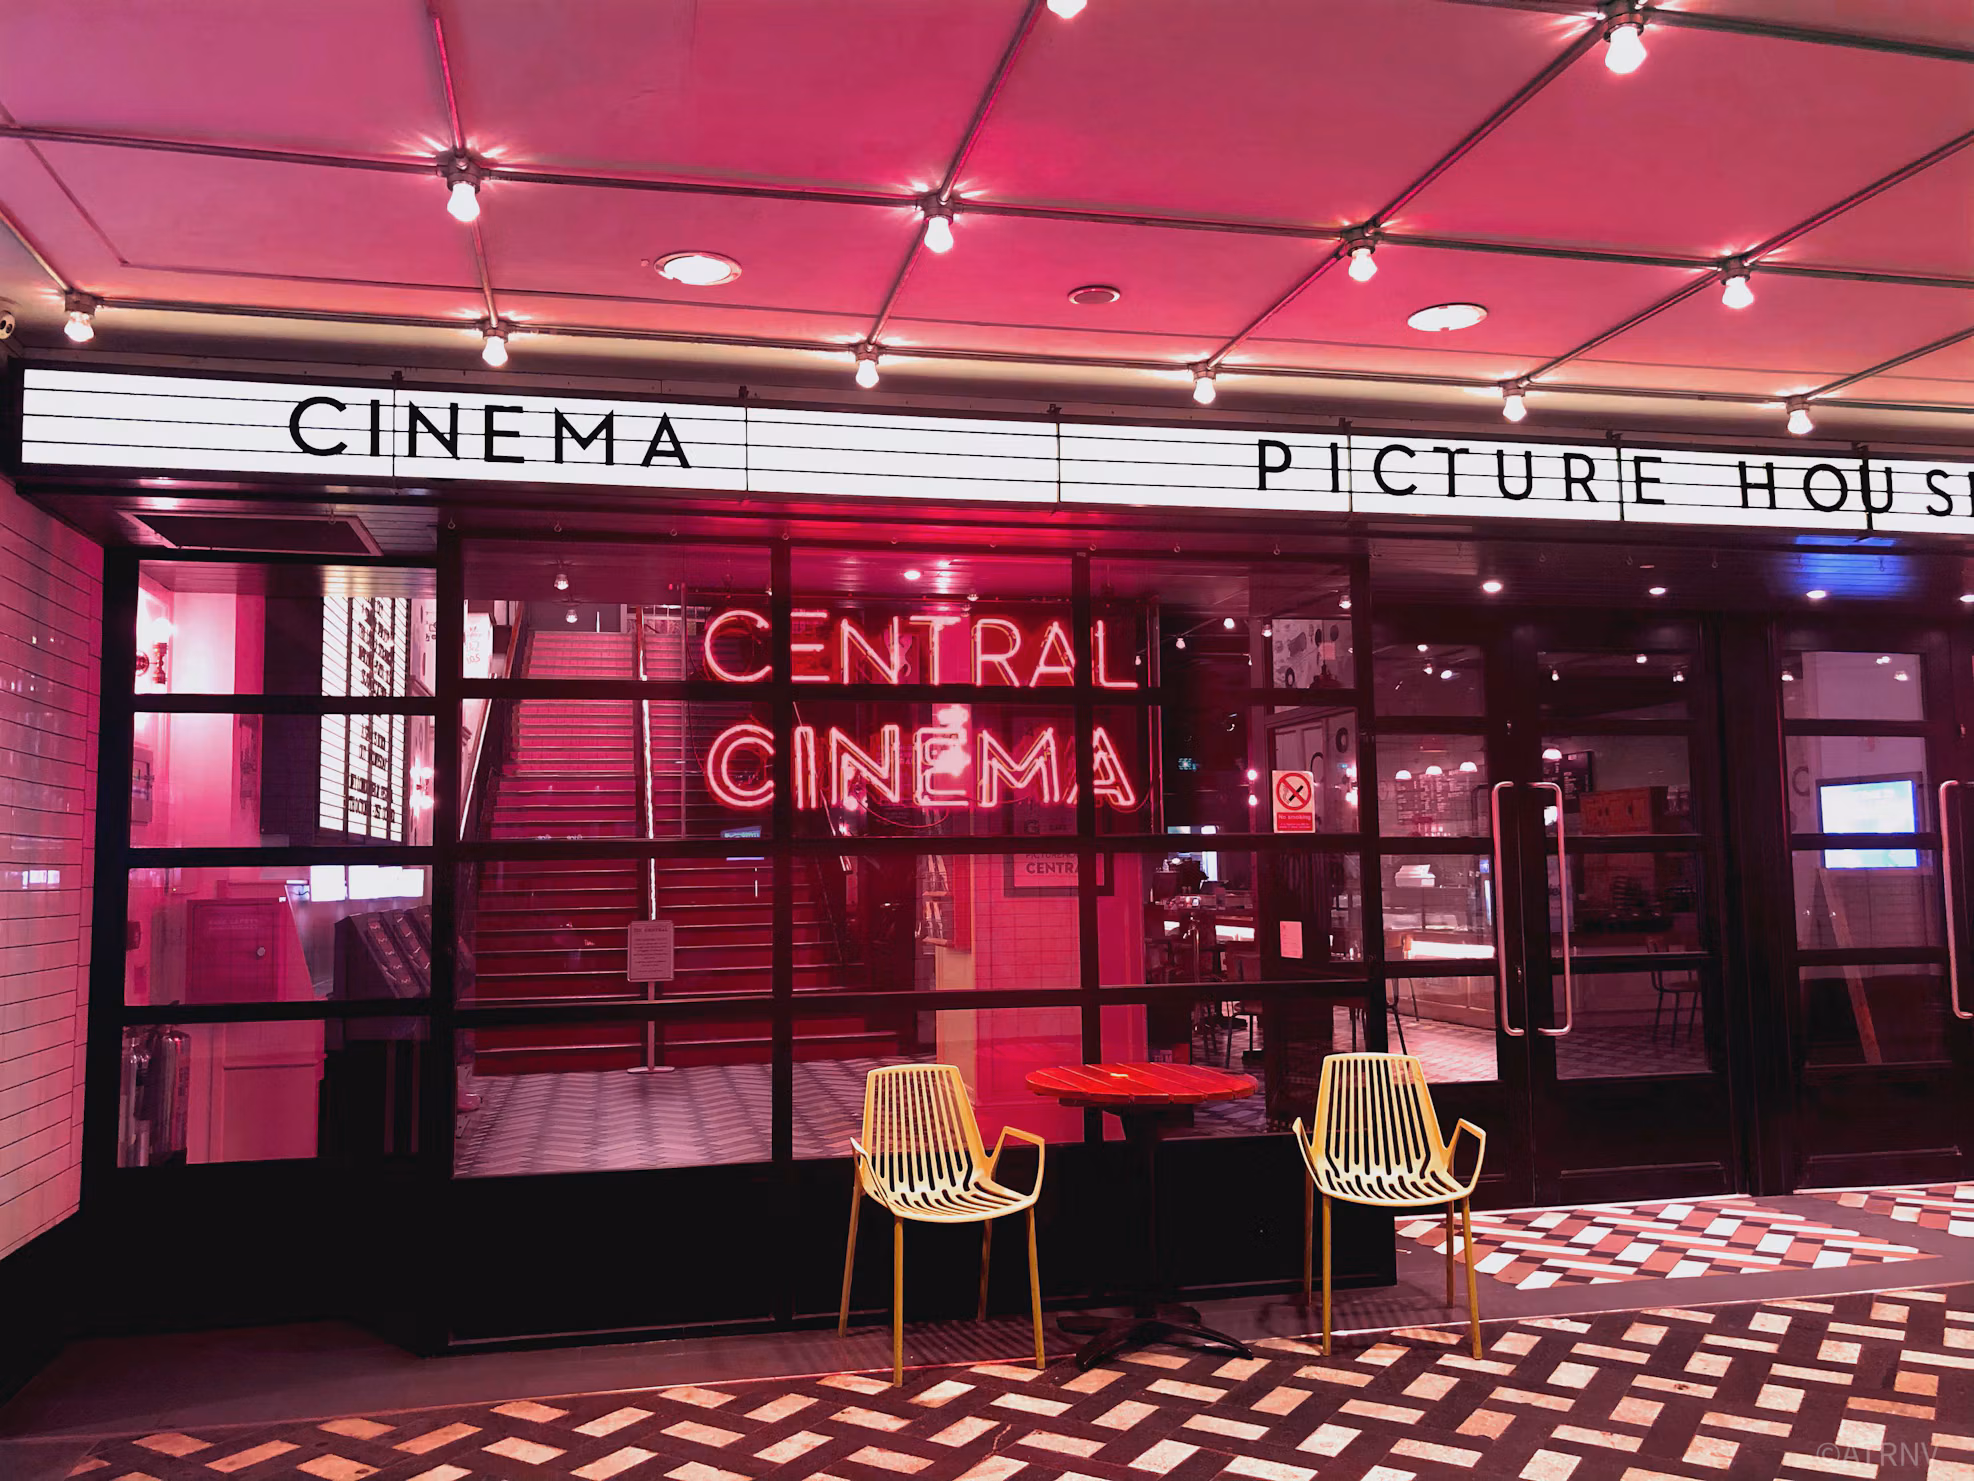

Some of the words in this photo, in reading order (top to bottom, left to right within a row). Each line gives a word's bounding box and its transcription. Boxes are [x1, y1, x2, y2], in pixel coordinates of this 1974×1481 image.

[289, 396, 691, 468] CINEMA
[1258, 439, 1665, 504] PICTURE
[1738, 460, 1974, 517] HOUS
[704, 610, 1138, 689] CENTRAL
[707, 722, 1136, 808] CINEMA
